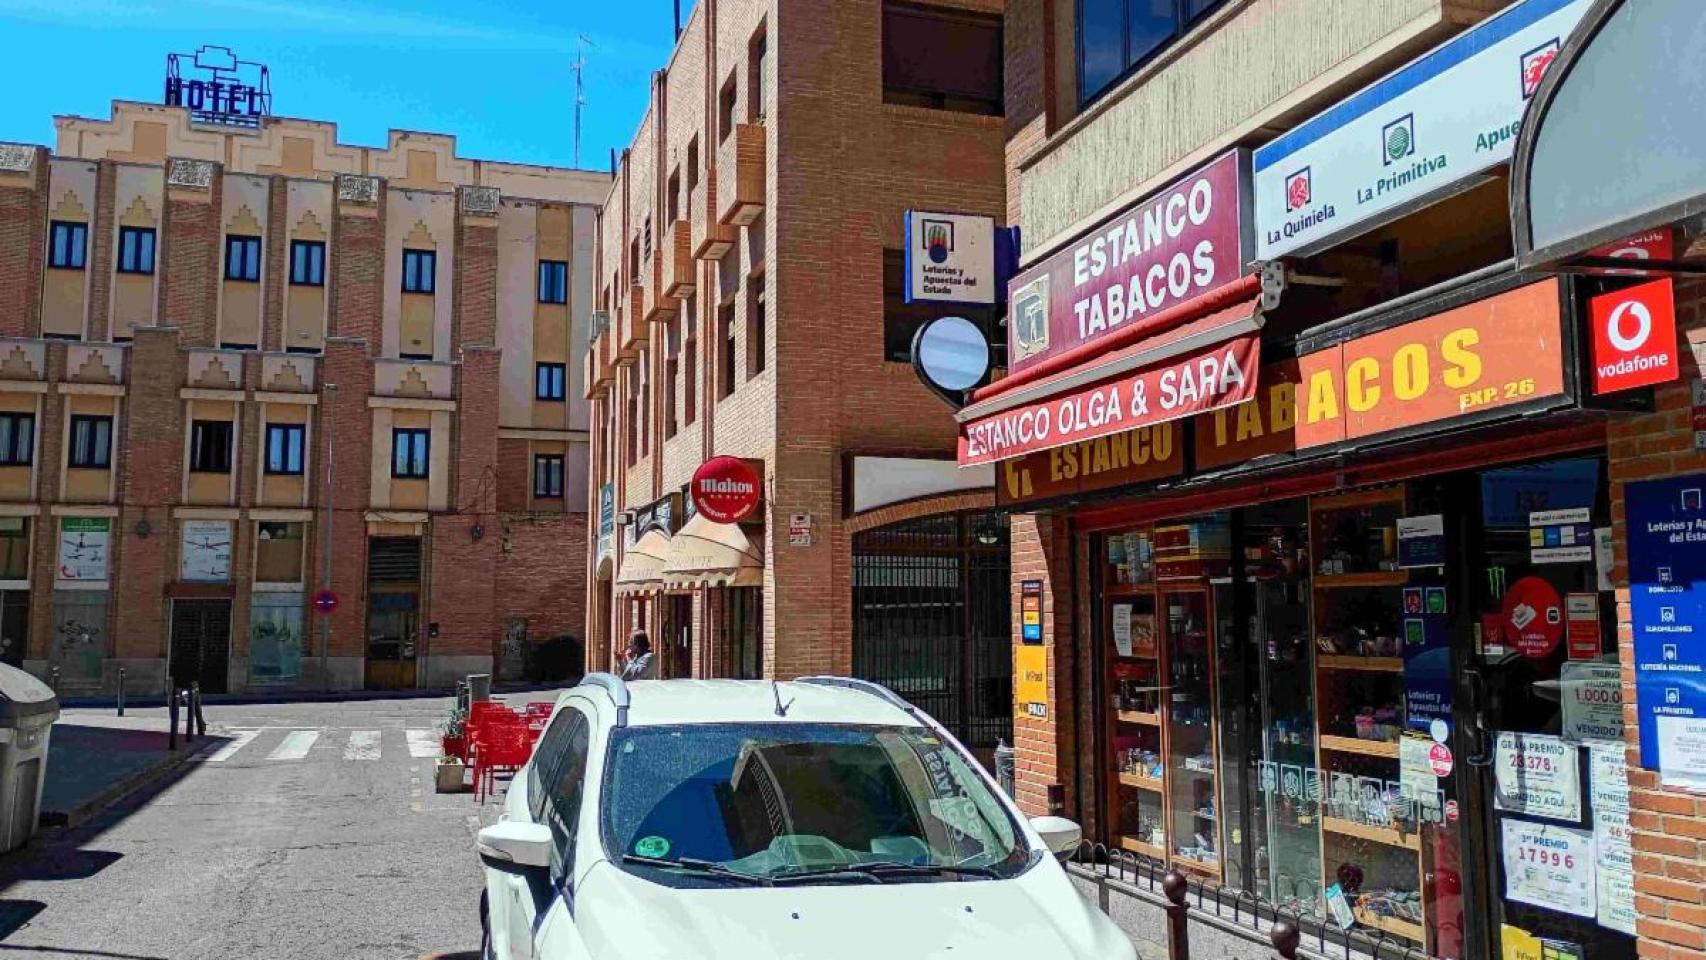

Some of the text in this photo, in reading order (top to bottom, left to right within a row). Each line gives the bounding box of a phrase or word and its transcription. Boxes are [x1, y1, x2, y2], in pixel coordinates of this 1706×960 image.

[165, 77, 261, 115] HOTEL
[1357, 152, 1447, 205] La Primitiva
[1074, 178, 1212, 287] ESTANCO
[1267, 202, 1336, 246] La Quiniela
[924, 275, 977, 286] Apuestas del
[959, 269, 965, 277] y
[924, 286, 952, 294] Estado
[1074, 240, 1215, 338] TABACOS
[1598, 353, 1669, 379] vodafone
[1211, 327, 1482, 447] TABACOS
[1503, 377, 1535, 401] 26
[966, 351, 1245, 457] ESTANCO OLGA & SARA
[1051, 422, 1172, 482] ESTANCO
[701, 478, 753, 493] Mahou
[1669, 532, 1684, 543] del
[1529, 743, 1565, 755] PREMIO
[1533, 836, 1569, 849] PREMIO
